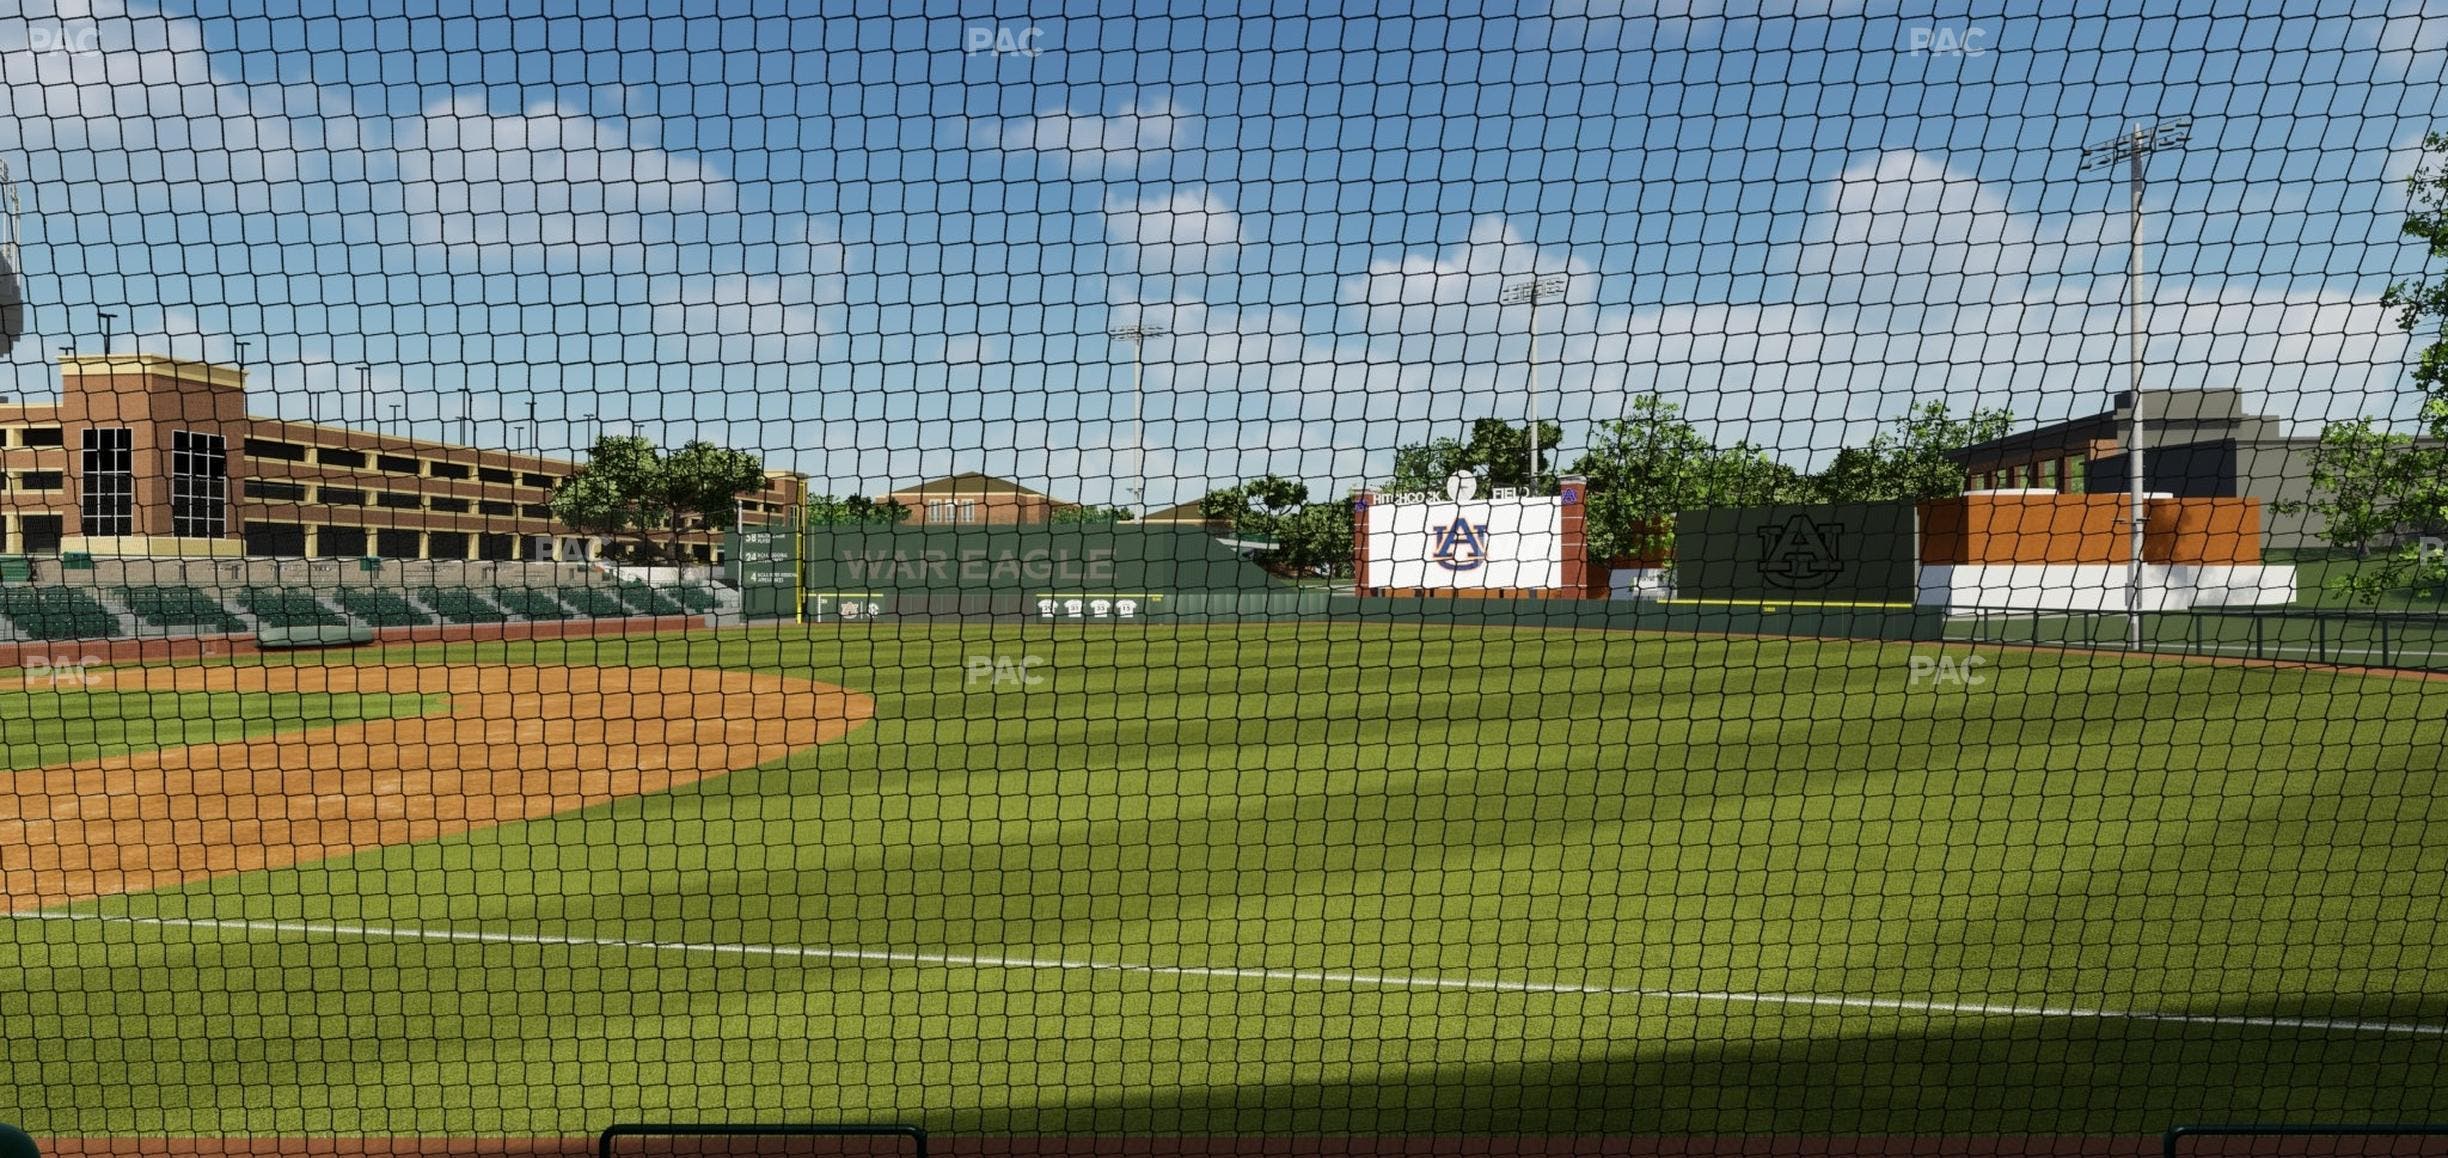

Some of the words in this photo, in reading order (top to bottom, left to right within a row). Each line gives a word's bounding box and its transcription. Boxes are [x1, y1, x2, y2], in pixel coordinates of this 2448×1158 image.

[1492, 486, 1530, 500] FIELD
[745, 552, 757, 562] 24
[842, 549, 948, 580] WAR
[962, 548, 1119, 580] EAGLE
[750, 572, 757, 582] 4
